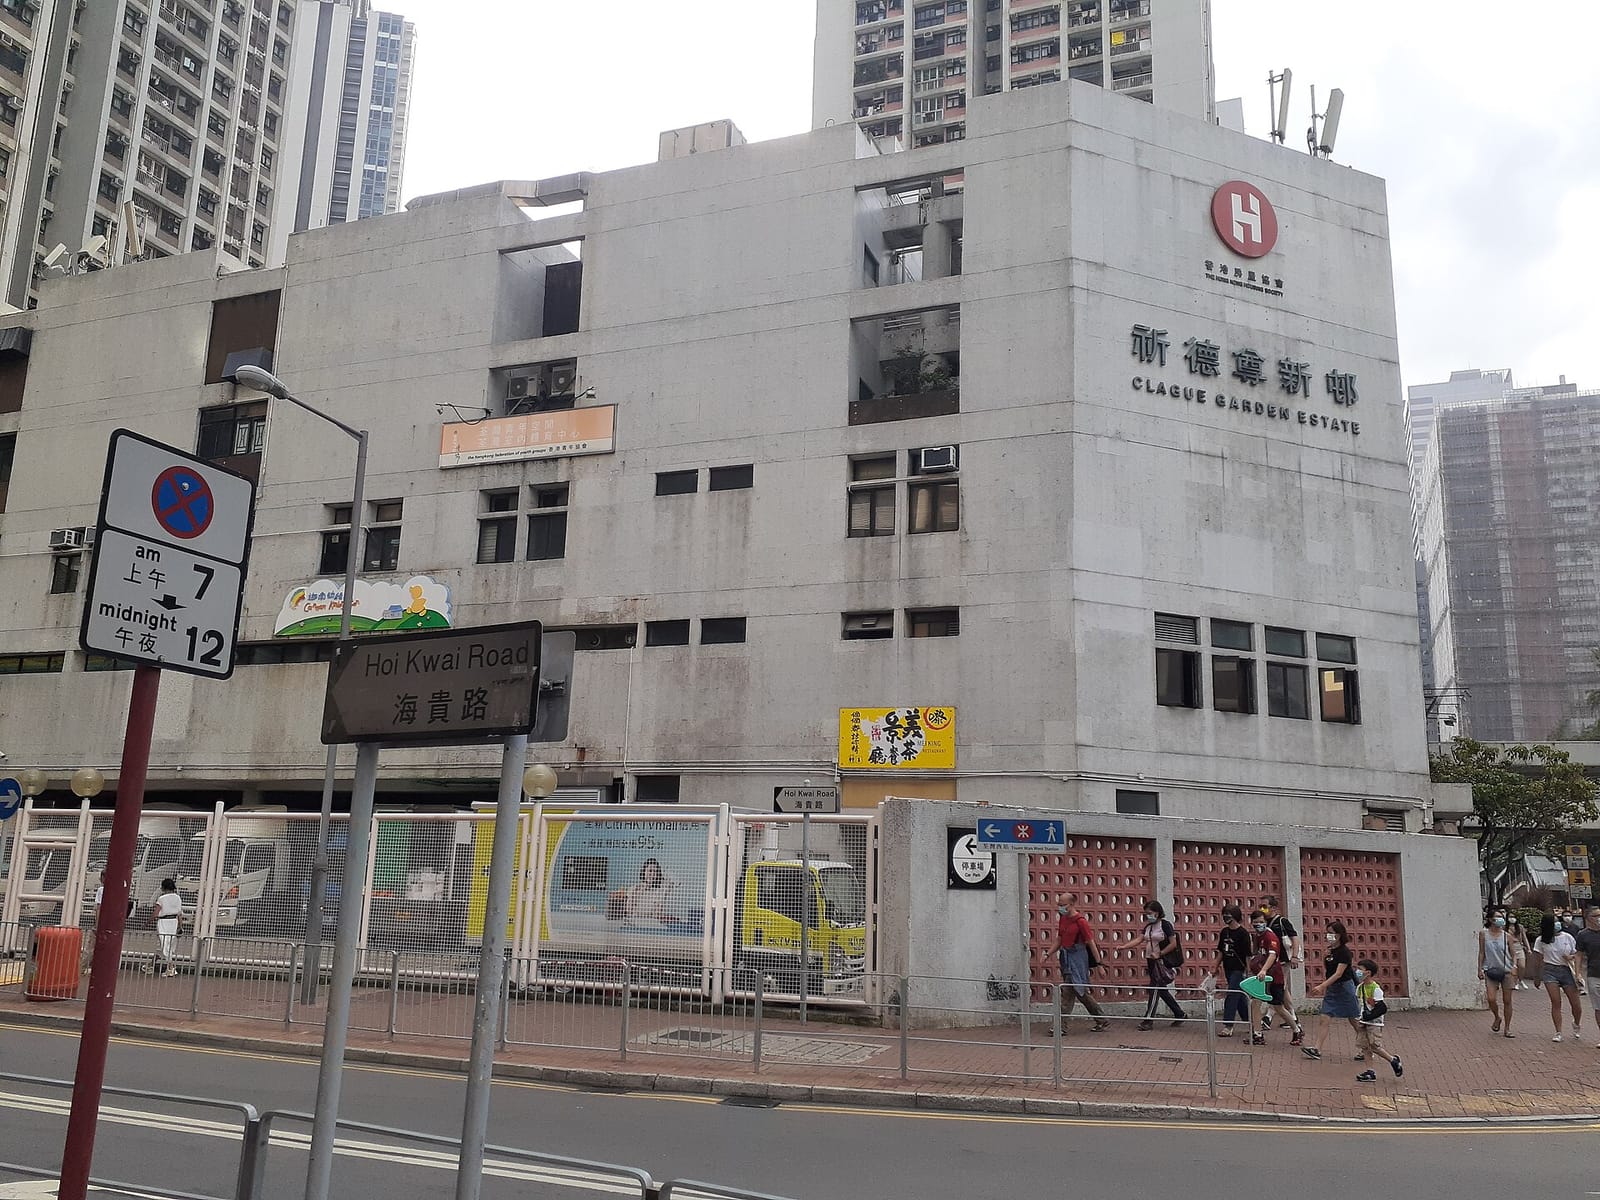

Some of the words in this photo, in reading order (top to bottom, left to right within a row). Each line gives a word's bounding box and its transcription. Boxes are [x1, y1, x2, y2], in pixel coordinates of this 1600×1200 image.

[1131, 323, 1360, 408] 祈德尊新邨
[1132, 376, 1206, 403] CLAGUE
[1215, 393, 1290, 420] GARDEN
[1297, 410, 1361, 435] ESTATE
[135, 545, 161, 563] am
[123, 562, 167, 590] 上午
[193, 563, 215, 600] 7
[99, 602, 178, 632] midnight
[115, 626, 158, 654] 午夜
[186, 626, 225, 667] 12
[365, 653, 399, 677] Hoi
[405, 647, 460, 675] Kwai
[467, 640, 529, 669] Road
[392, 686, 489, 726] 海貴路
[784, 790, 797, 798] Hoi
[798, 790, 815, 798] Kwai
[816, 790, 835, 798] Road
[961, 861, 984, 872] 停車場
